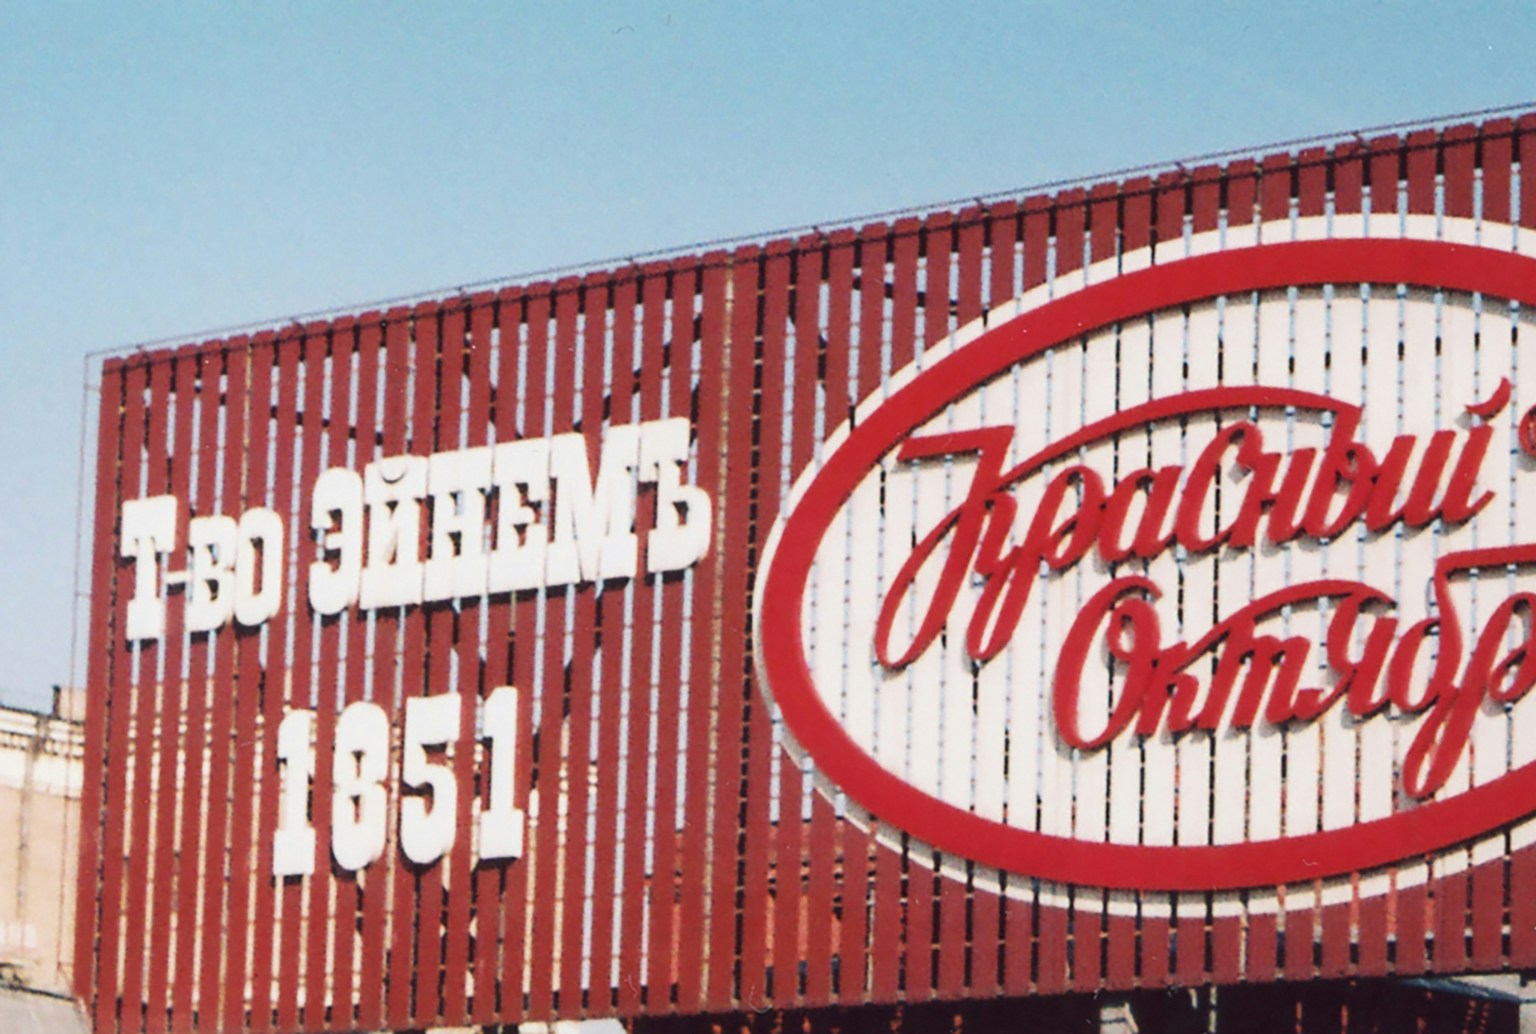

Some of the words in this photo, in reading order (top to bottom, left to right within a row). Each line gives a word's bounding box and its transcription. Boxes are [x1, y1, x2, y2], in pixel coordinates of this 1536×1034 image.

[308, 416, 712, 616] ЭЙНЕМЪ
[874, 377, 1512, 671] Красный
[273, 686, 524, 876] 1851
